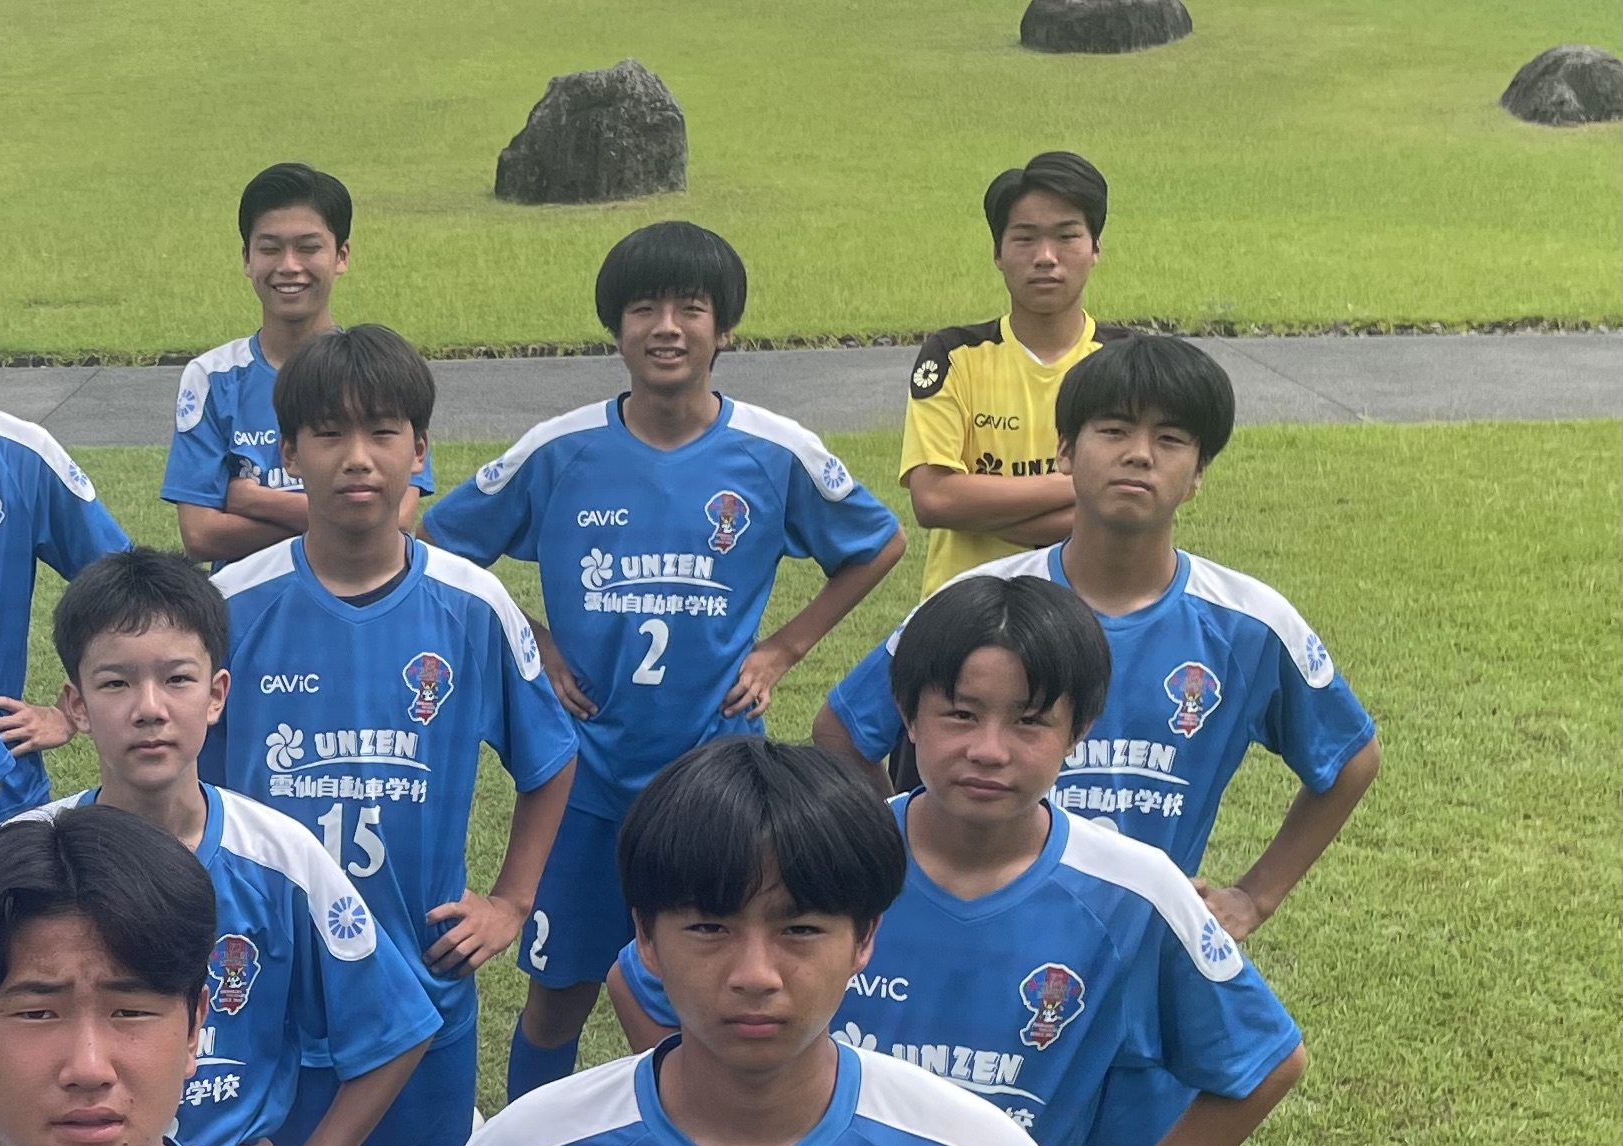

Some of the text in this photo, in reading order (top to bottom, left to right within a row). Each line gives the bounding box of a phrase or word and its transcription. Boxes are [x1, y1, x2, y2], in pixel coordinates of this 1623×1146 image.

[233, 429, 277, 446] GAViC
[577, 509, 629, 527] GAViC
[620, 553, 714, 580] UNZEN
[584, 591, 728, 616] 雲仙自動車学校
[632, 618, 669, 685] 2
[260, 673, 320, 694] GAViC
[314, 729, 419, 759] UNZEN
[1064, 738, 1177, 773] UNZEN
[317, 803, 386, 878] 15
[530, 909, 550, 971] 2
